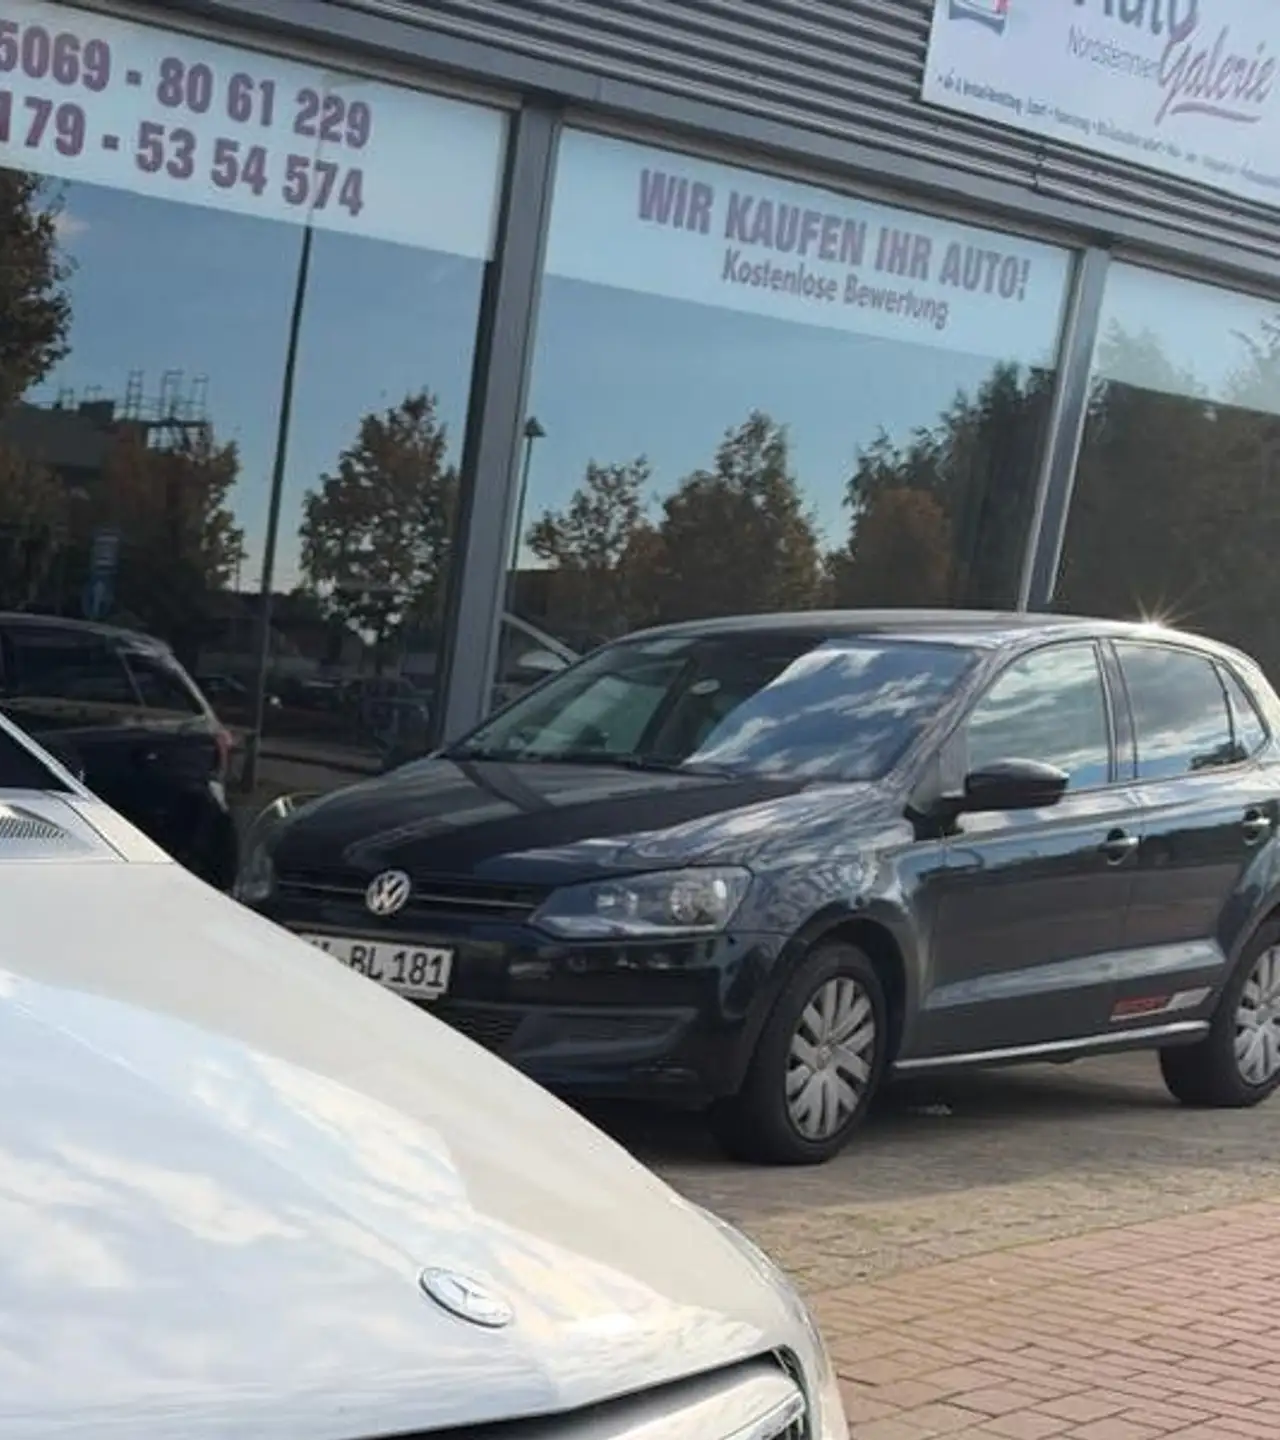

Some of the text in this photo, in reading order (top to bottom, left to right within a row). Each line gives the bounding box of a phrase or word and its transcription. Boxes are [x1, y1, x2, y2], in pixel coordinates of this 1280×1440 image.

[157, 57, 213, 115] 80
[226, 72, 276, 128] 61
[293, 87, 372, 151] 229
[135, 122, 195, 181] 53
[210, 137, 267, 197] 54
[282, 154, 364, 217] 574
[637, 168, 1032, 302] WIR KAUFEN IHR AUTO!
[721, 248, 950, 331] Kostenlose Bewertung
[390, 950, 444, 987] 181
